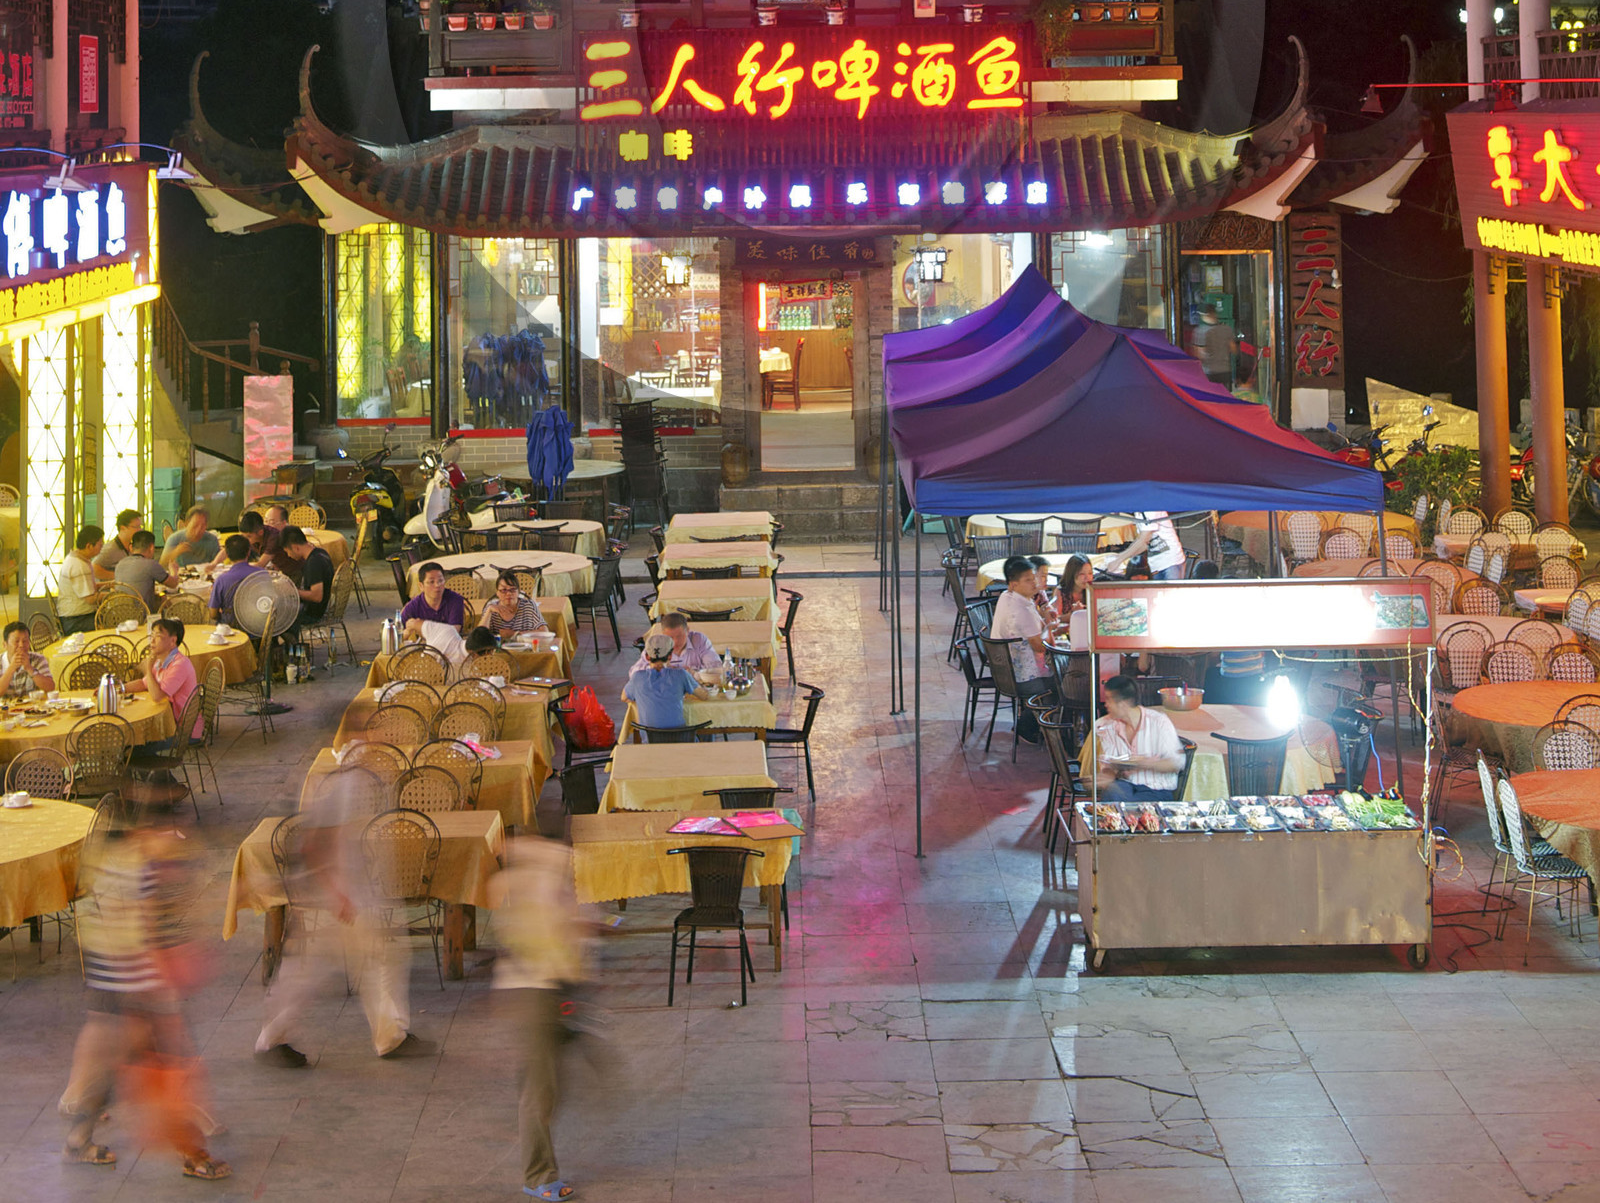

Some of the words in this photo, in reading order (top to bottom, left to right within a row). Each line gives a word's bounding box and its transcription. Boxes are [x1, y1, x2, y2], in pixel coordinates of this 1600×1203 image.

[580, 36, 1024, 120] 三人行啤酒鱼
[1295, 229, 1340, 377] 三人行
